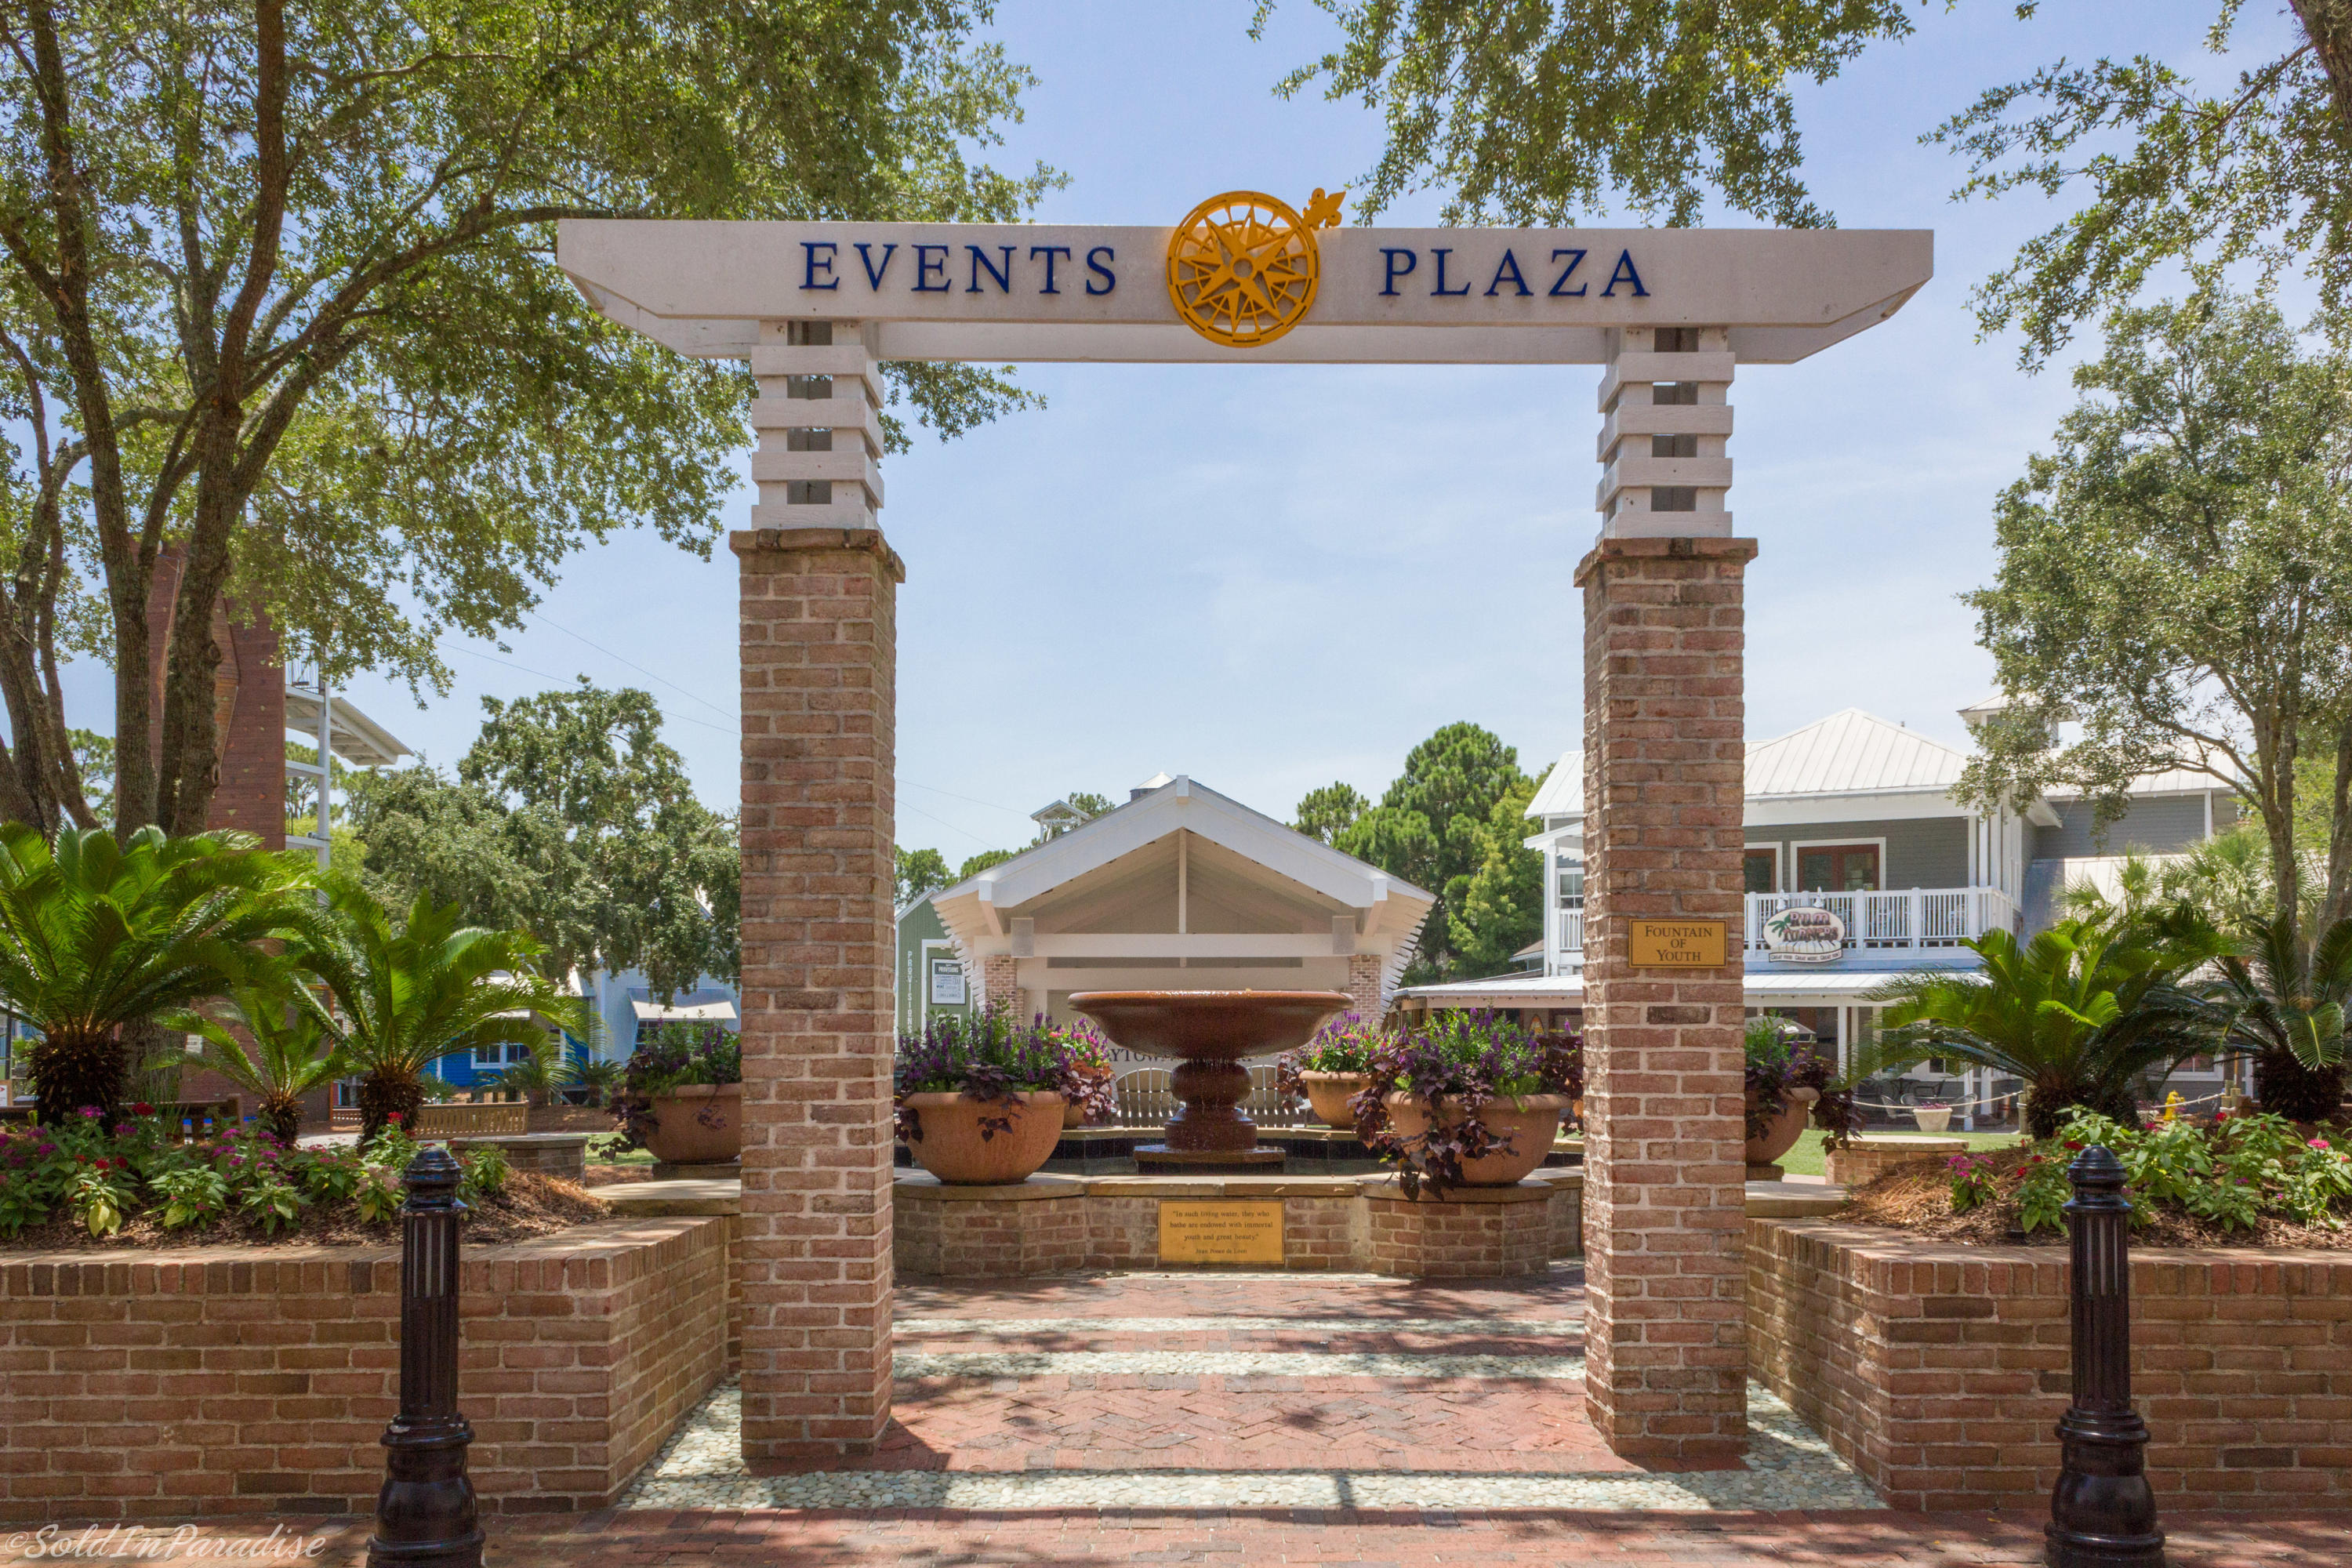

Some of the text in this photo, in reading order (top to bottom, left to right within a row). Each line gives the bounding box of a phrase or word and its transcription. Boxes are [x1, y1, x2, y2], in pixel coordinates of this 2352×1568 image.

[798, 241, 1652, 298] EVENTS PLAZA
[1645, 925, 1712, 938] FOUNTAIN
[1671, 938, 1687, 949] OF
[1656, 949, 1701, 962] YOUTH
